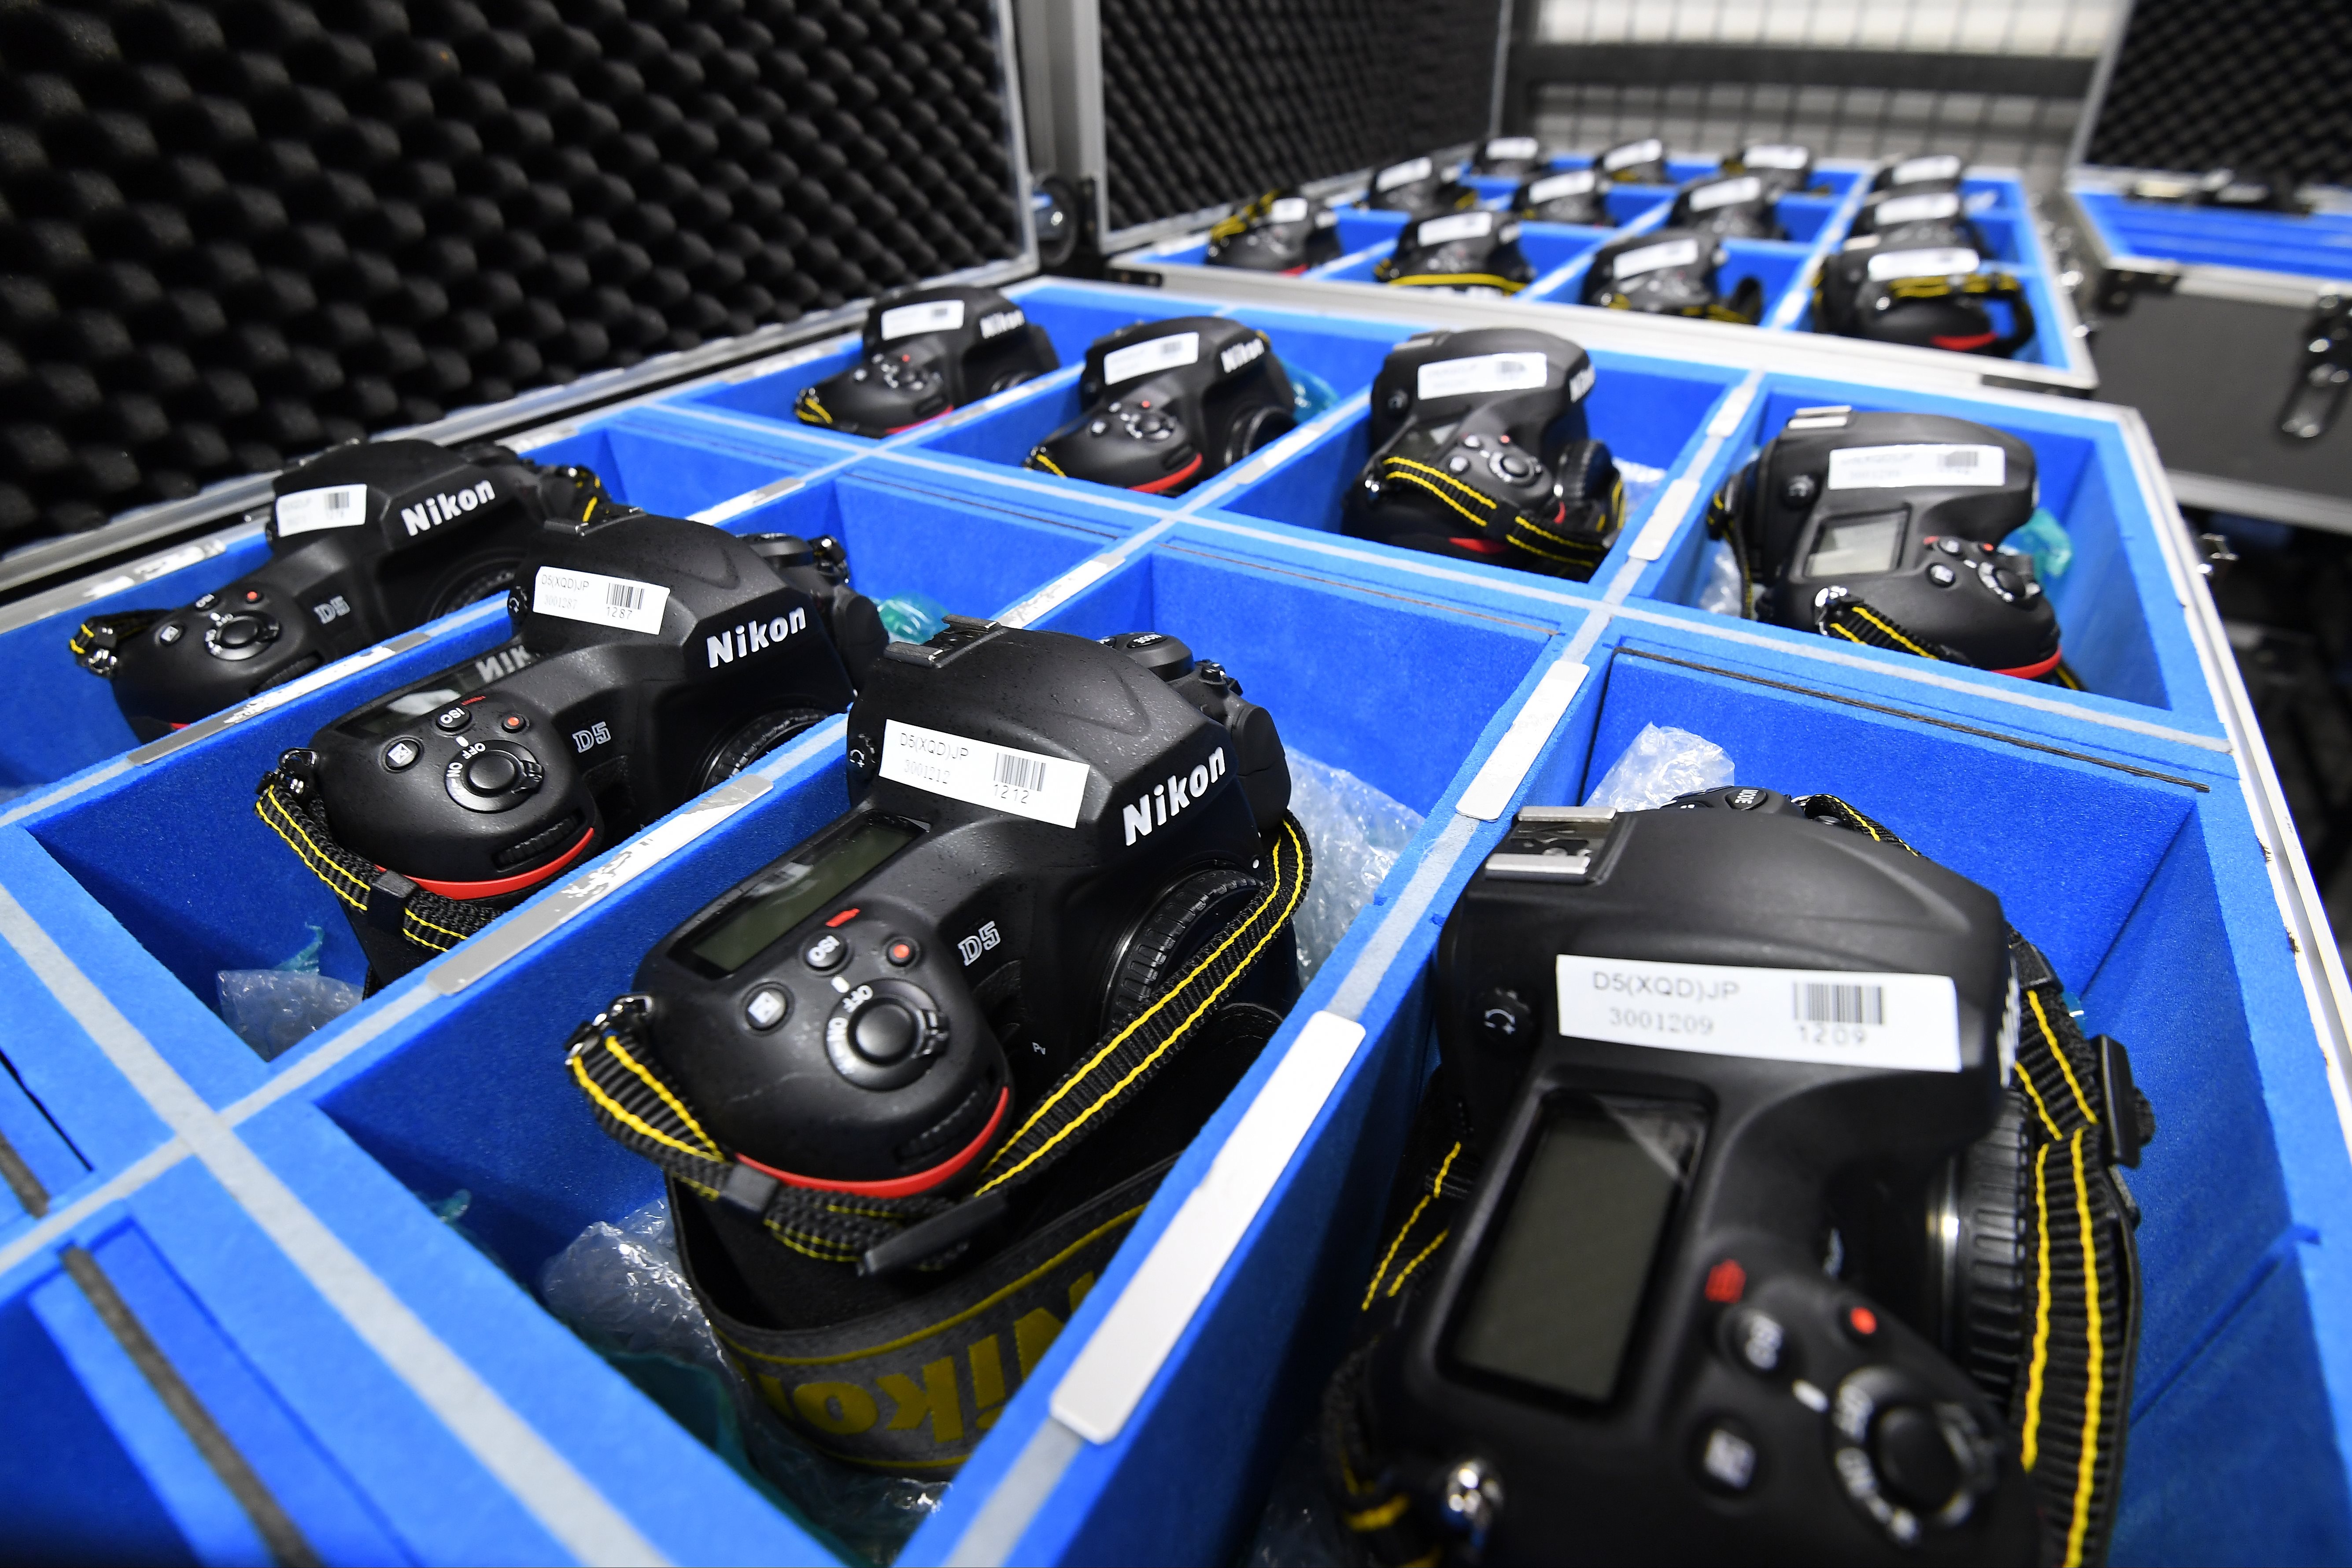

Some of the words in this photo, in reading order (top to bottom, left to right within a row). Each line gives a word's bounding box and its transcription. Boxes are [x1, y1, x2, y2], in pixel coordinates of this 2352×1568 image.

[400, 479, 496, 537] Nikon
[542, 574, 590, 593] D5(XQD)JP
[313, 595, 351, 624] D5
[544, 594, 578, 610] 3001287
[606, 607, 633, 620] 1287
[706, 606, 808, 668] Nikon
[440, 707, 465, 724] ISO
[572, 721, 611, 753] D5
[899, 732, 969, 761] D5(XQD)JP
[462, 742, 486, 760] OFF
[446, 762, 464, 778] ON
[904, 759, 951, 784] 3001212
[993, 783, 1030, 804] 1212
[1122, 745, 1226, 846] Nikon
[1734, 789, 1760, 805] MODE
[957, 920, 1001, 967] D5
[1592, 969, 1740, 1002] D5(XQD)JP
[1609, 1007, 1715, 1037] 3001209
[1796, 1024, 1868, 1047] 1209
